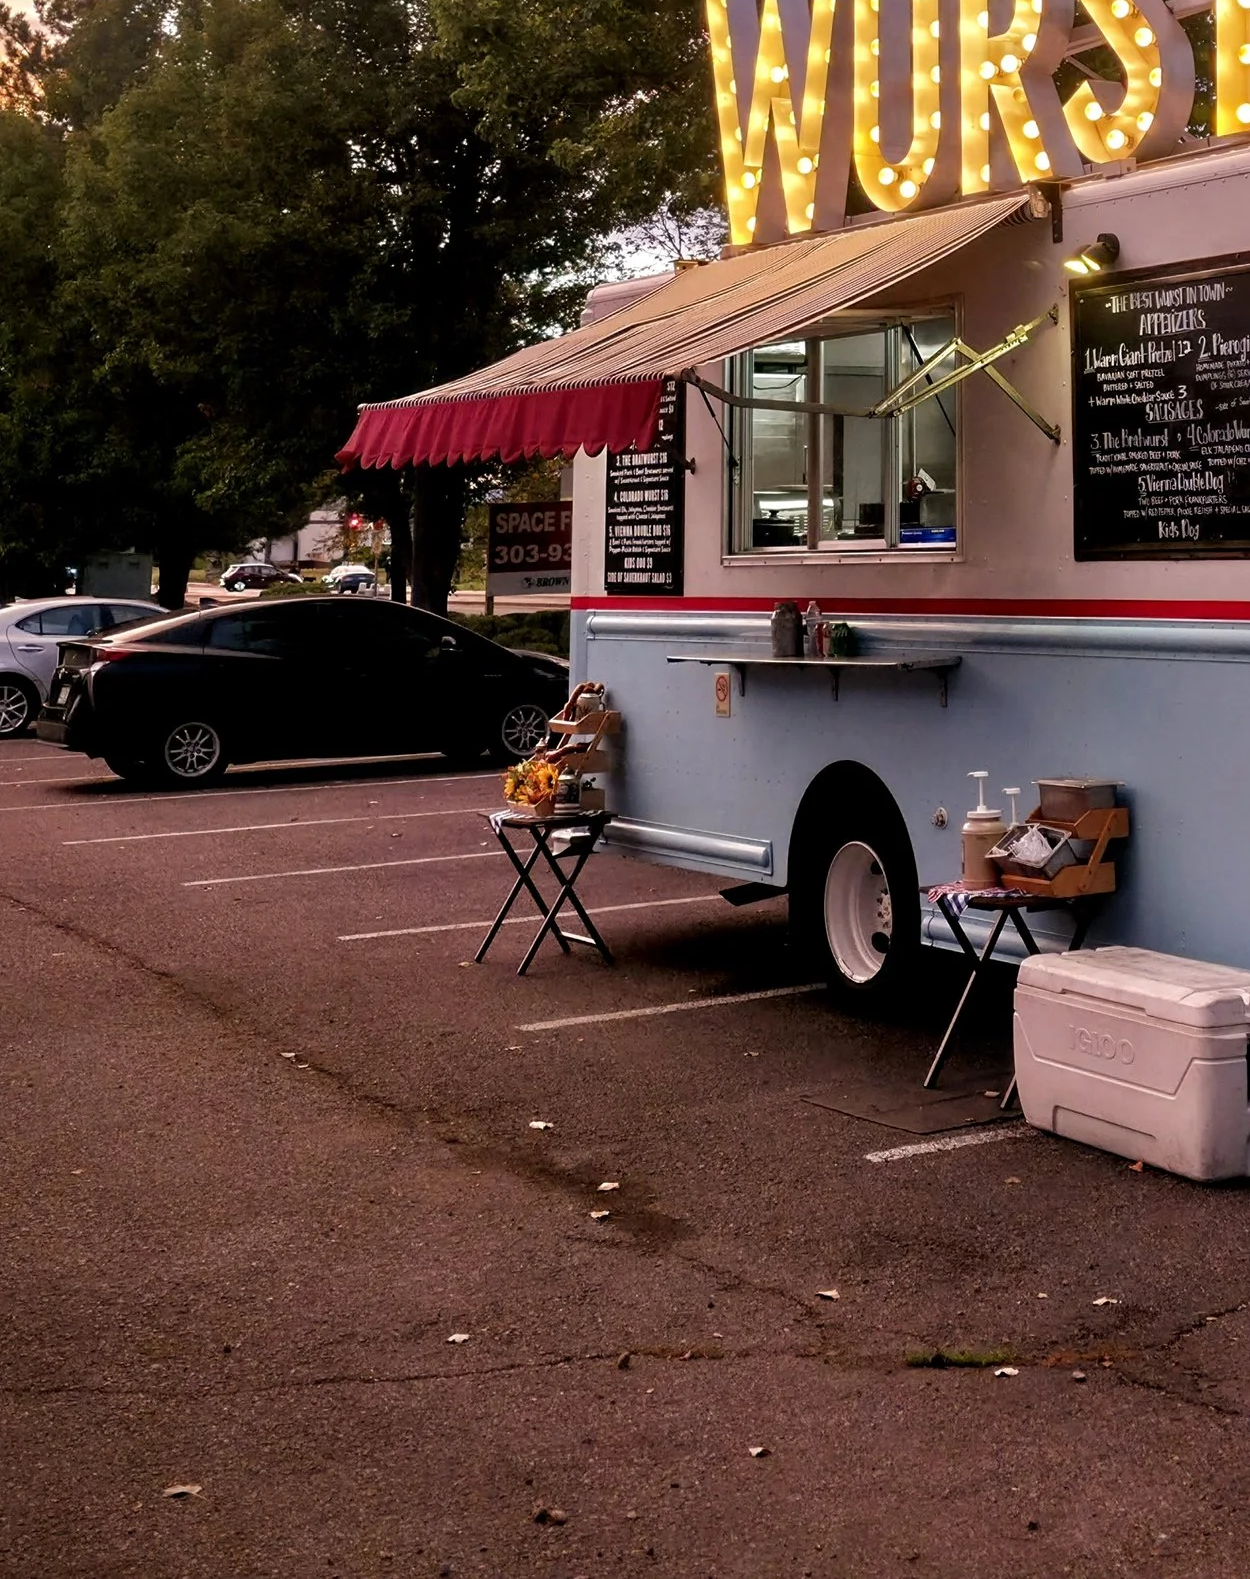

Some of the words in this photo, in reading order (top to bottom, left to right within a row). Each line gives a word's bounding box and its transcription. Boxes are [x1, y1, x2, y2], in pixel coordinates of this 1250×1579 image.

[1198, 282, 1225, 302] TOWN
[1119, 343, 1147, 366] Giant
[1148, 340, 1175, 363] Pretzel
[1178, 385, 1187, 398] 3
[1145, 399, 1204, 422] SAUSAGES
[1102, 432, 1120, 449] The
[1122, 428, 1169, 447] Bratwurst
[1147, 474, 1177, 492] Vienna
[1206, 471, 1224, 494] Dog
[496, 512, 556, 533] SPACE
[1159, 521, 1179, 538] Kids
[1182, 519, 1199, 540] Dog
[494, 543, 572, 564] 303-93
[536, 576, 568, 587] BROWN
